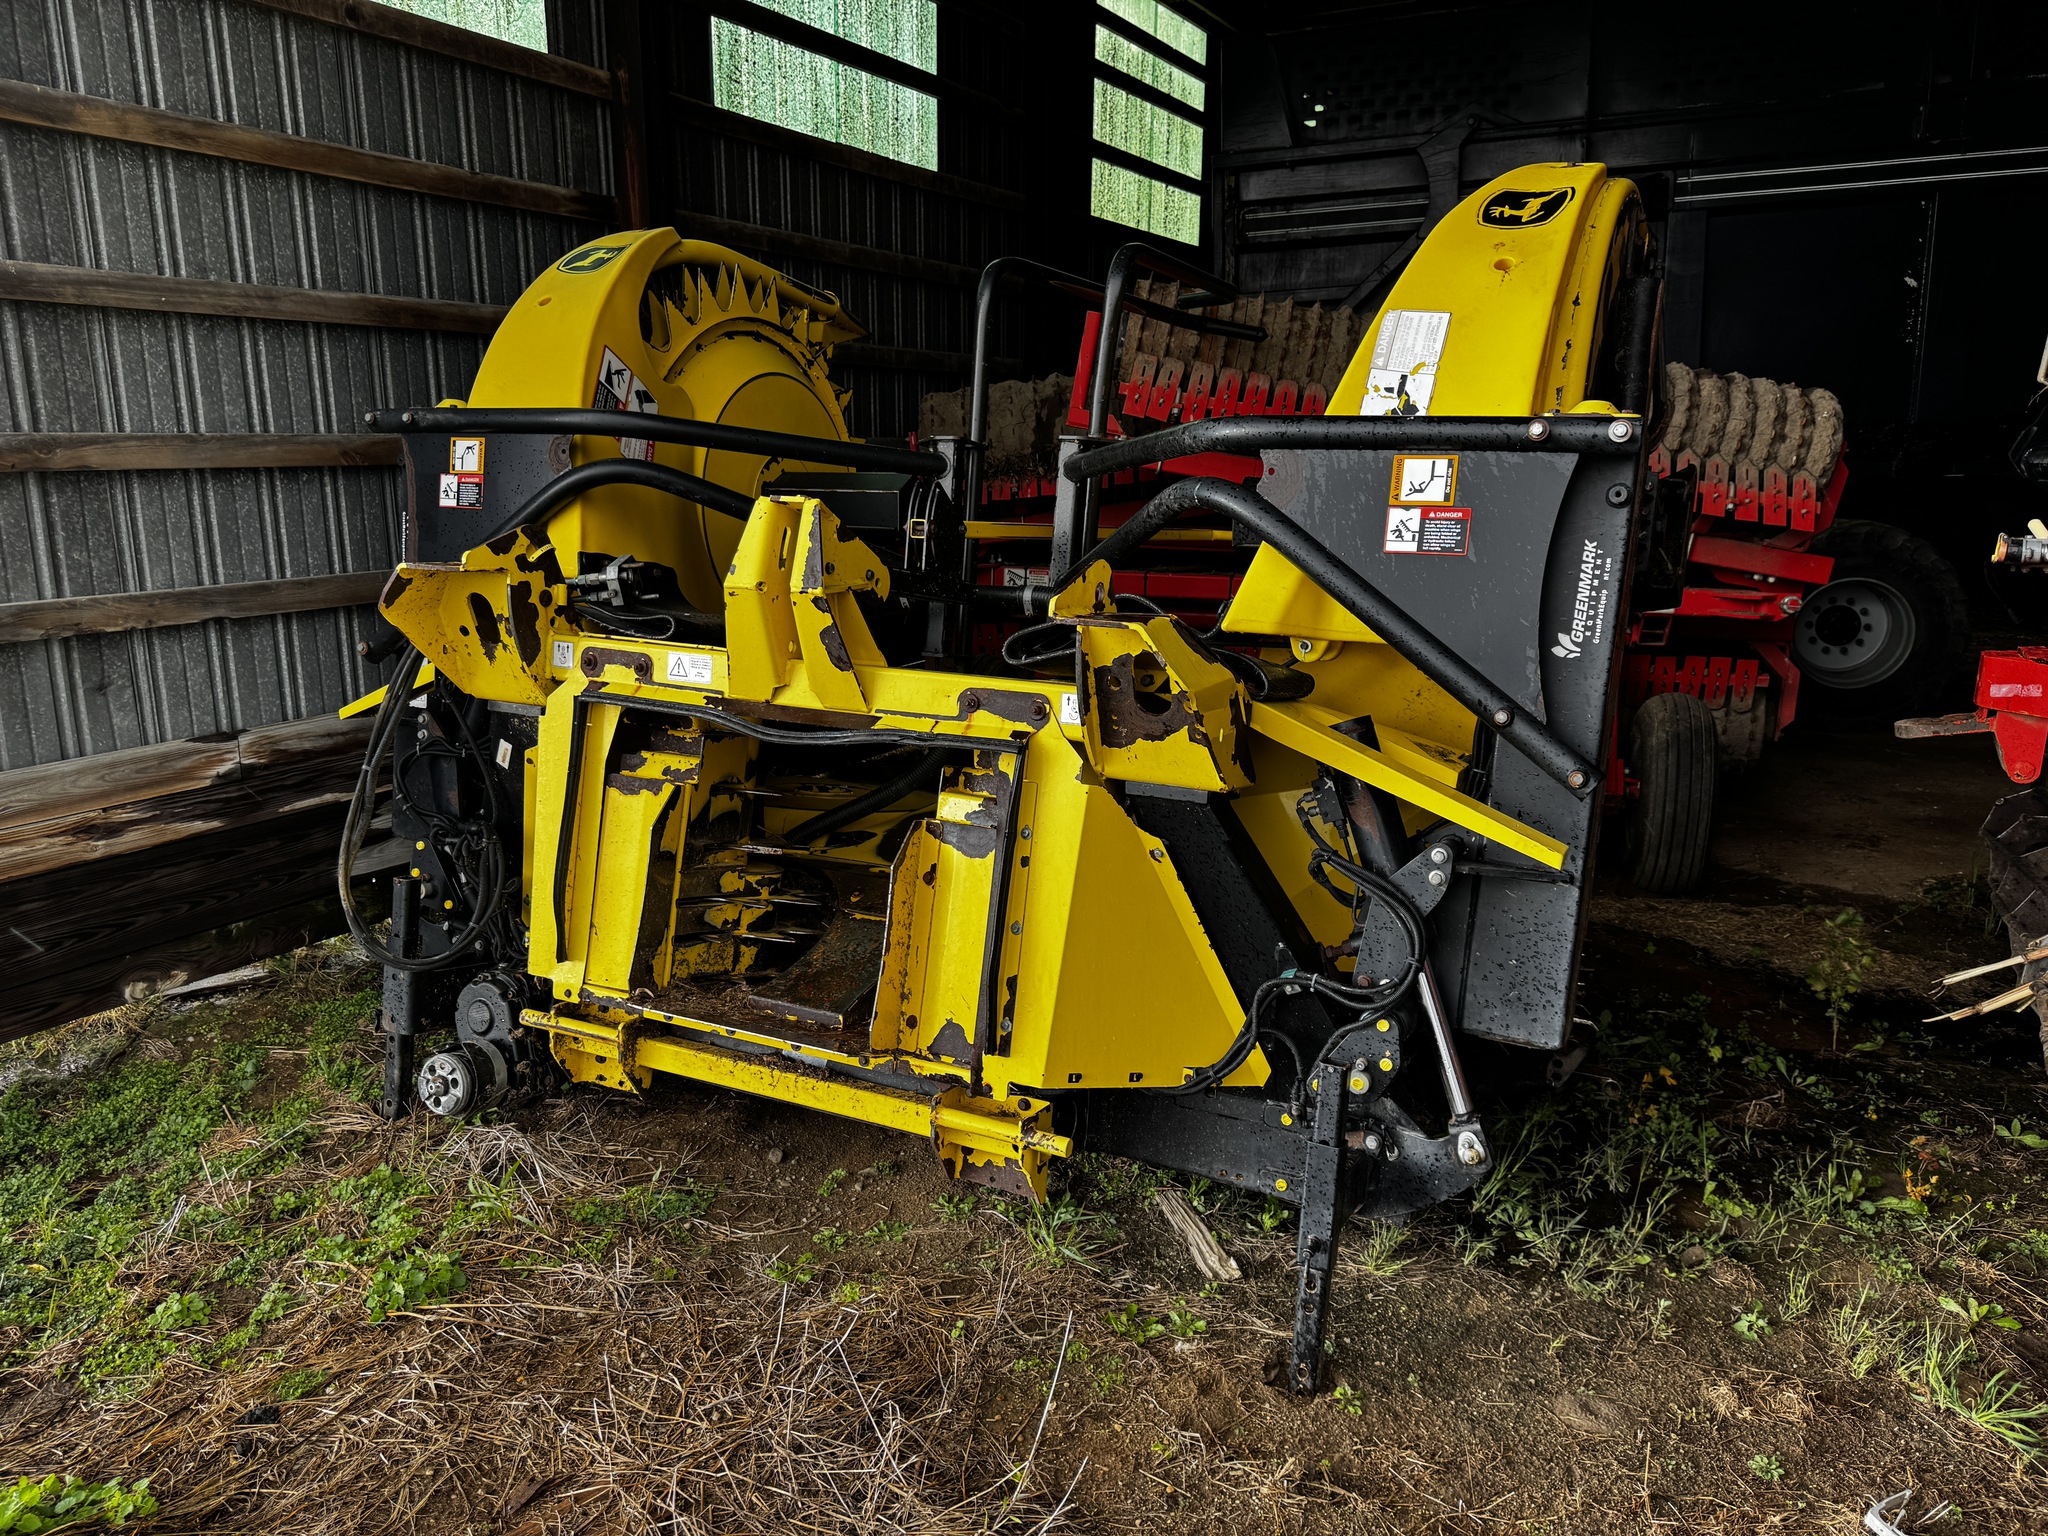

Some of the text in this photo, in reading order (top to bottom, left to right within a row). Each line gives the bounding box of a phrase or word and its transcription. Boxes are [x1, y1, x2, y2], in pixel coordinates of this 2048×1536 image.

[1378, 313, 1396, 353] DANGER
[1394, 458, 1403, 491] WARNING
[1571, 539, 1599, 644] GREENMARK
[1585, 549, 1604, 636] EQUIPMENT
